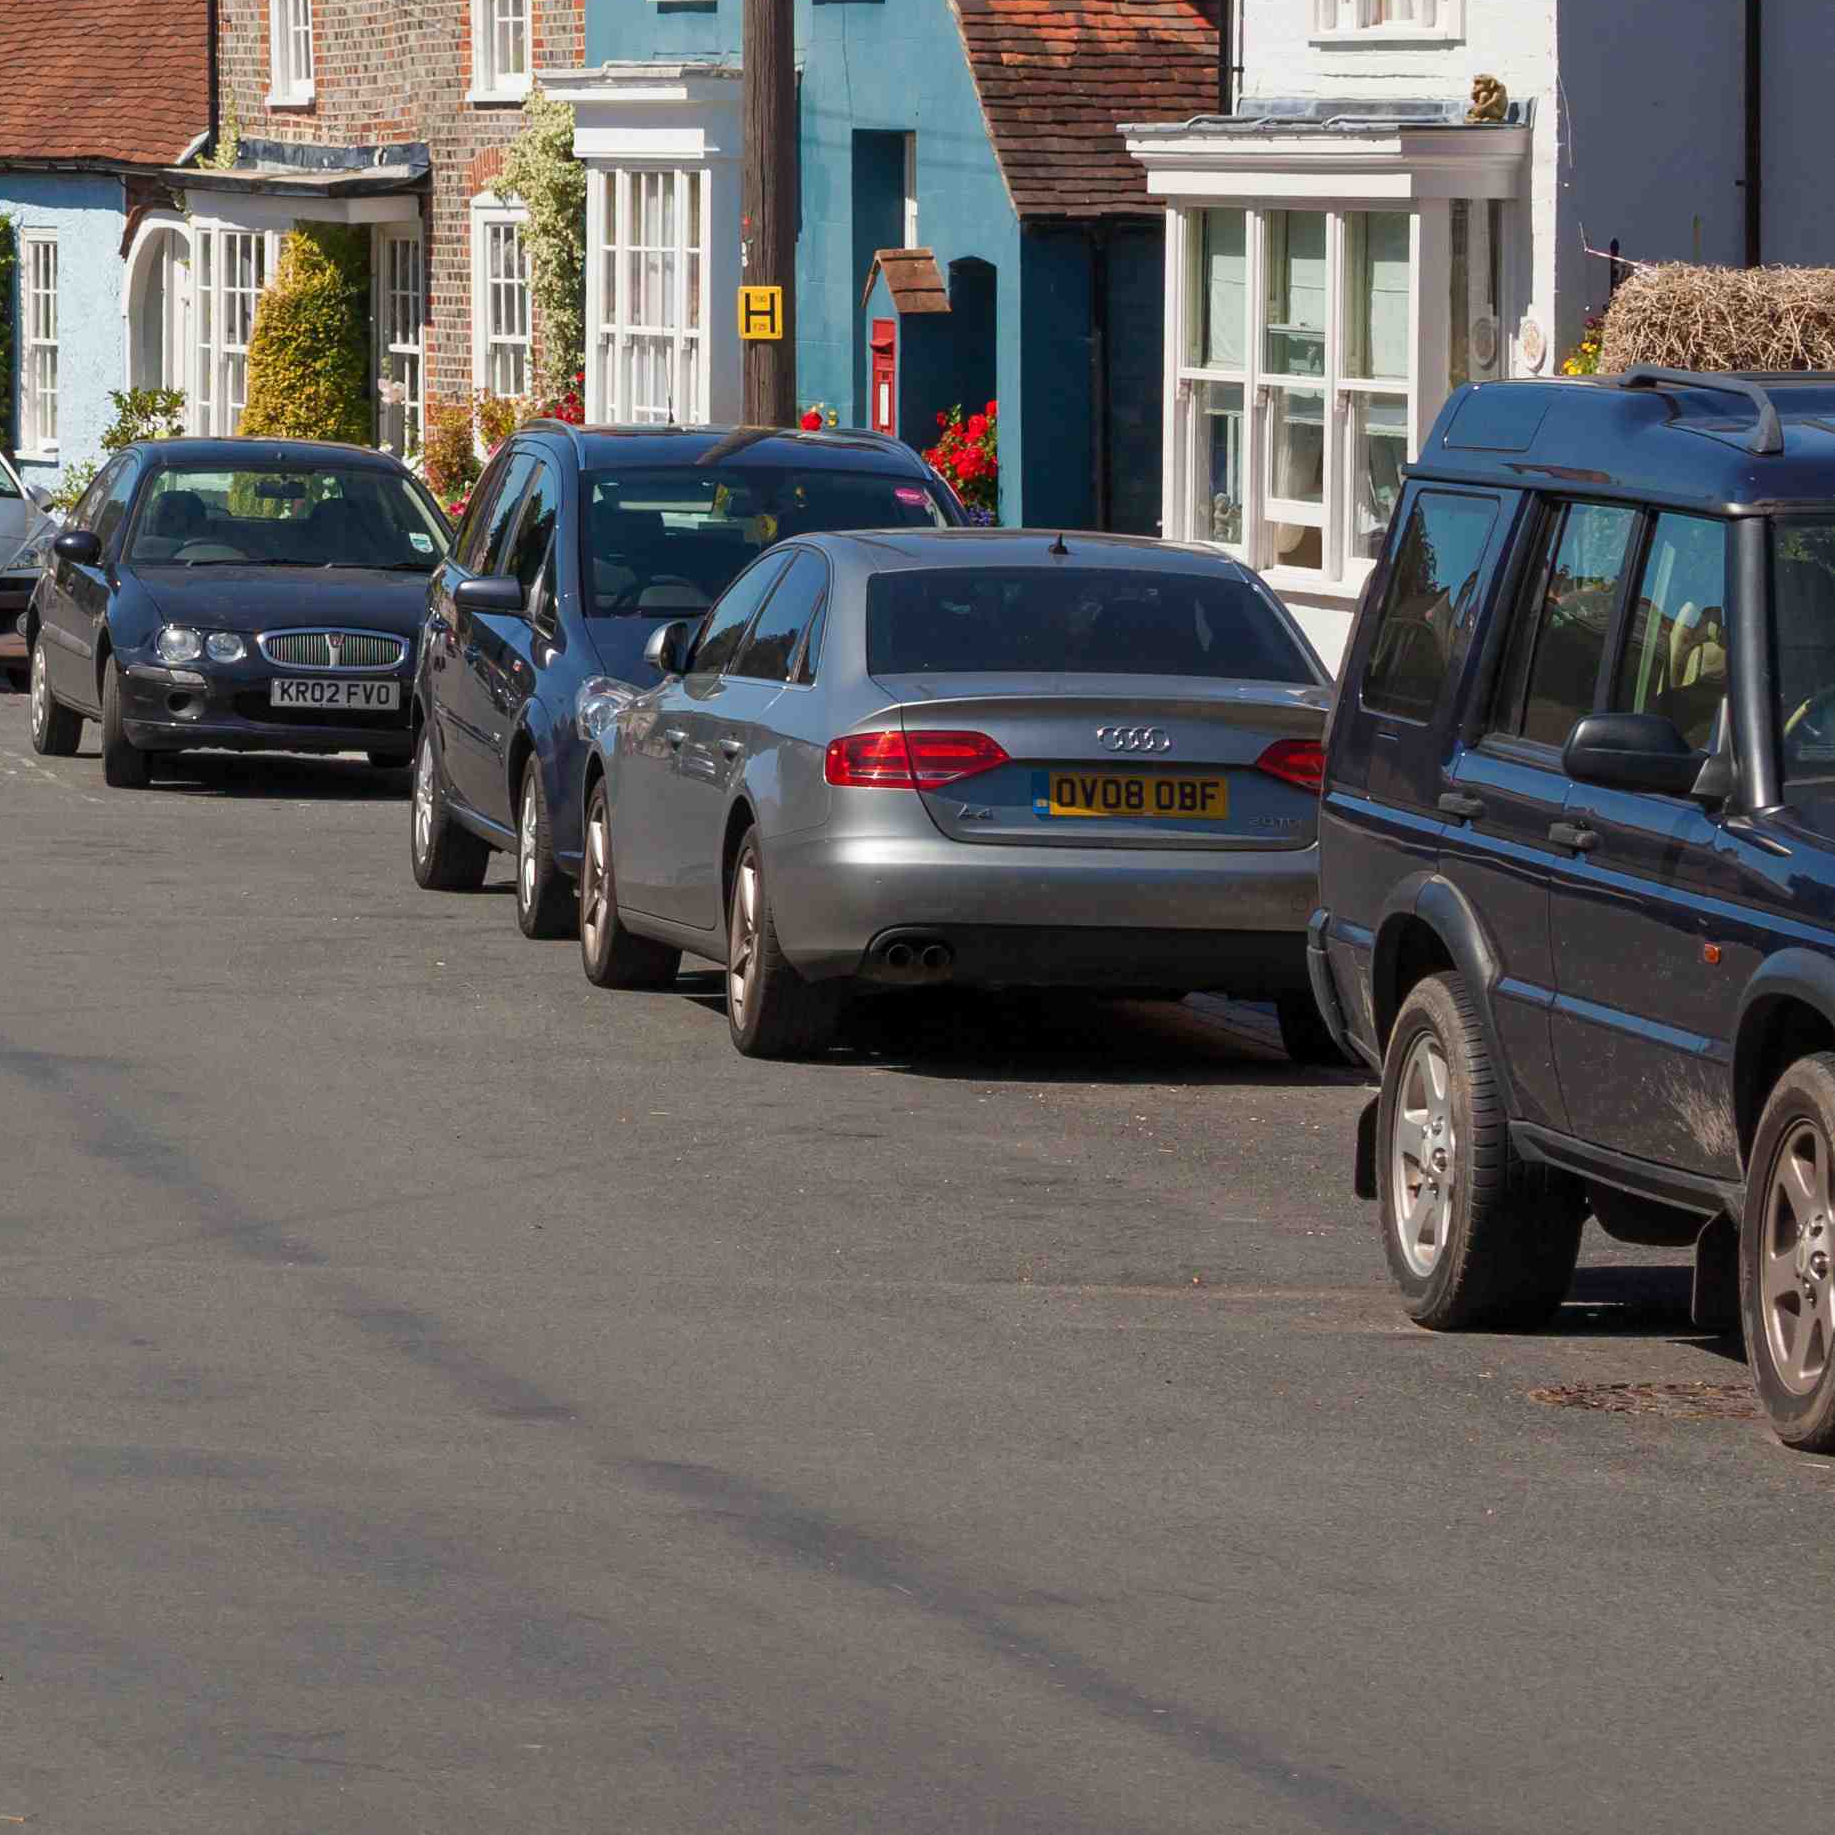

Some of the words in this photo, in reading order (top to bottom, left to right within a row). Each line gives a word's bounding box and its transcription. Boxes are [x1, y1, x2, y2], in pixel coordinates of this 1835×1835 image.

[745, 293, 775, 333] H
[279, 680, 340, 703] KR02
[347, 683, 390, 705] FVO
[1056, 778, 1144, 810] OV08
[1155, 781, 1220, 812] OBF
